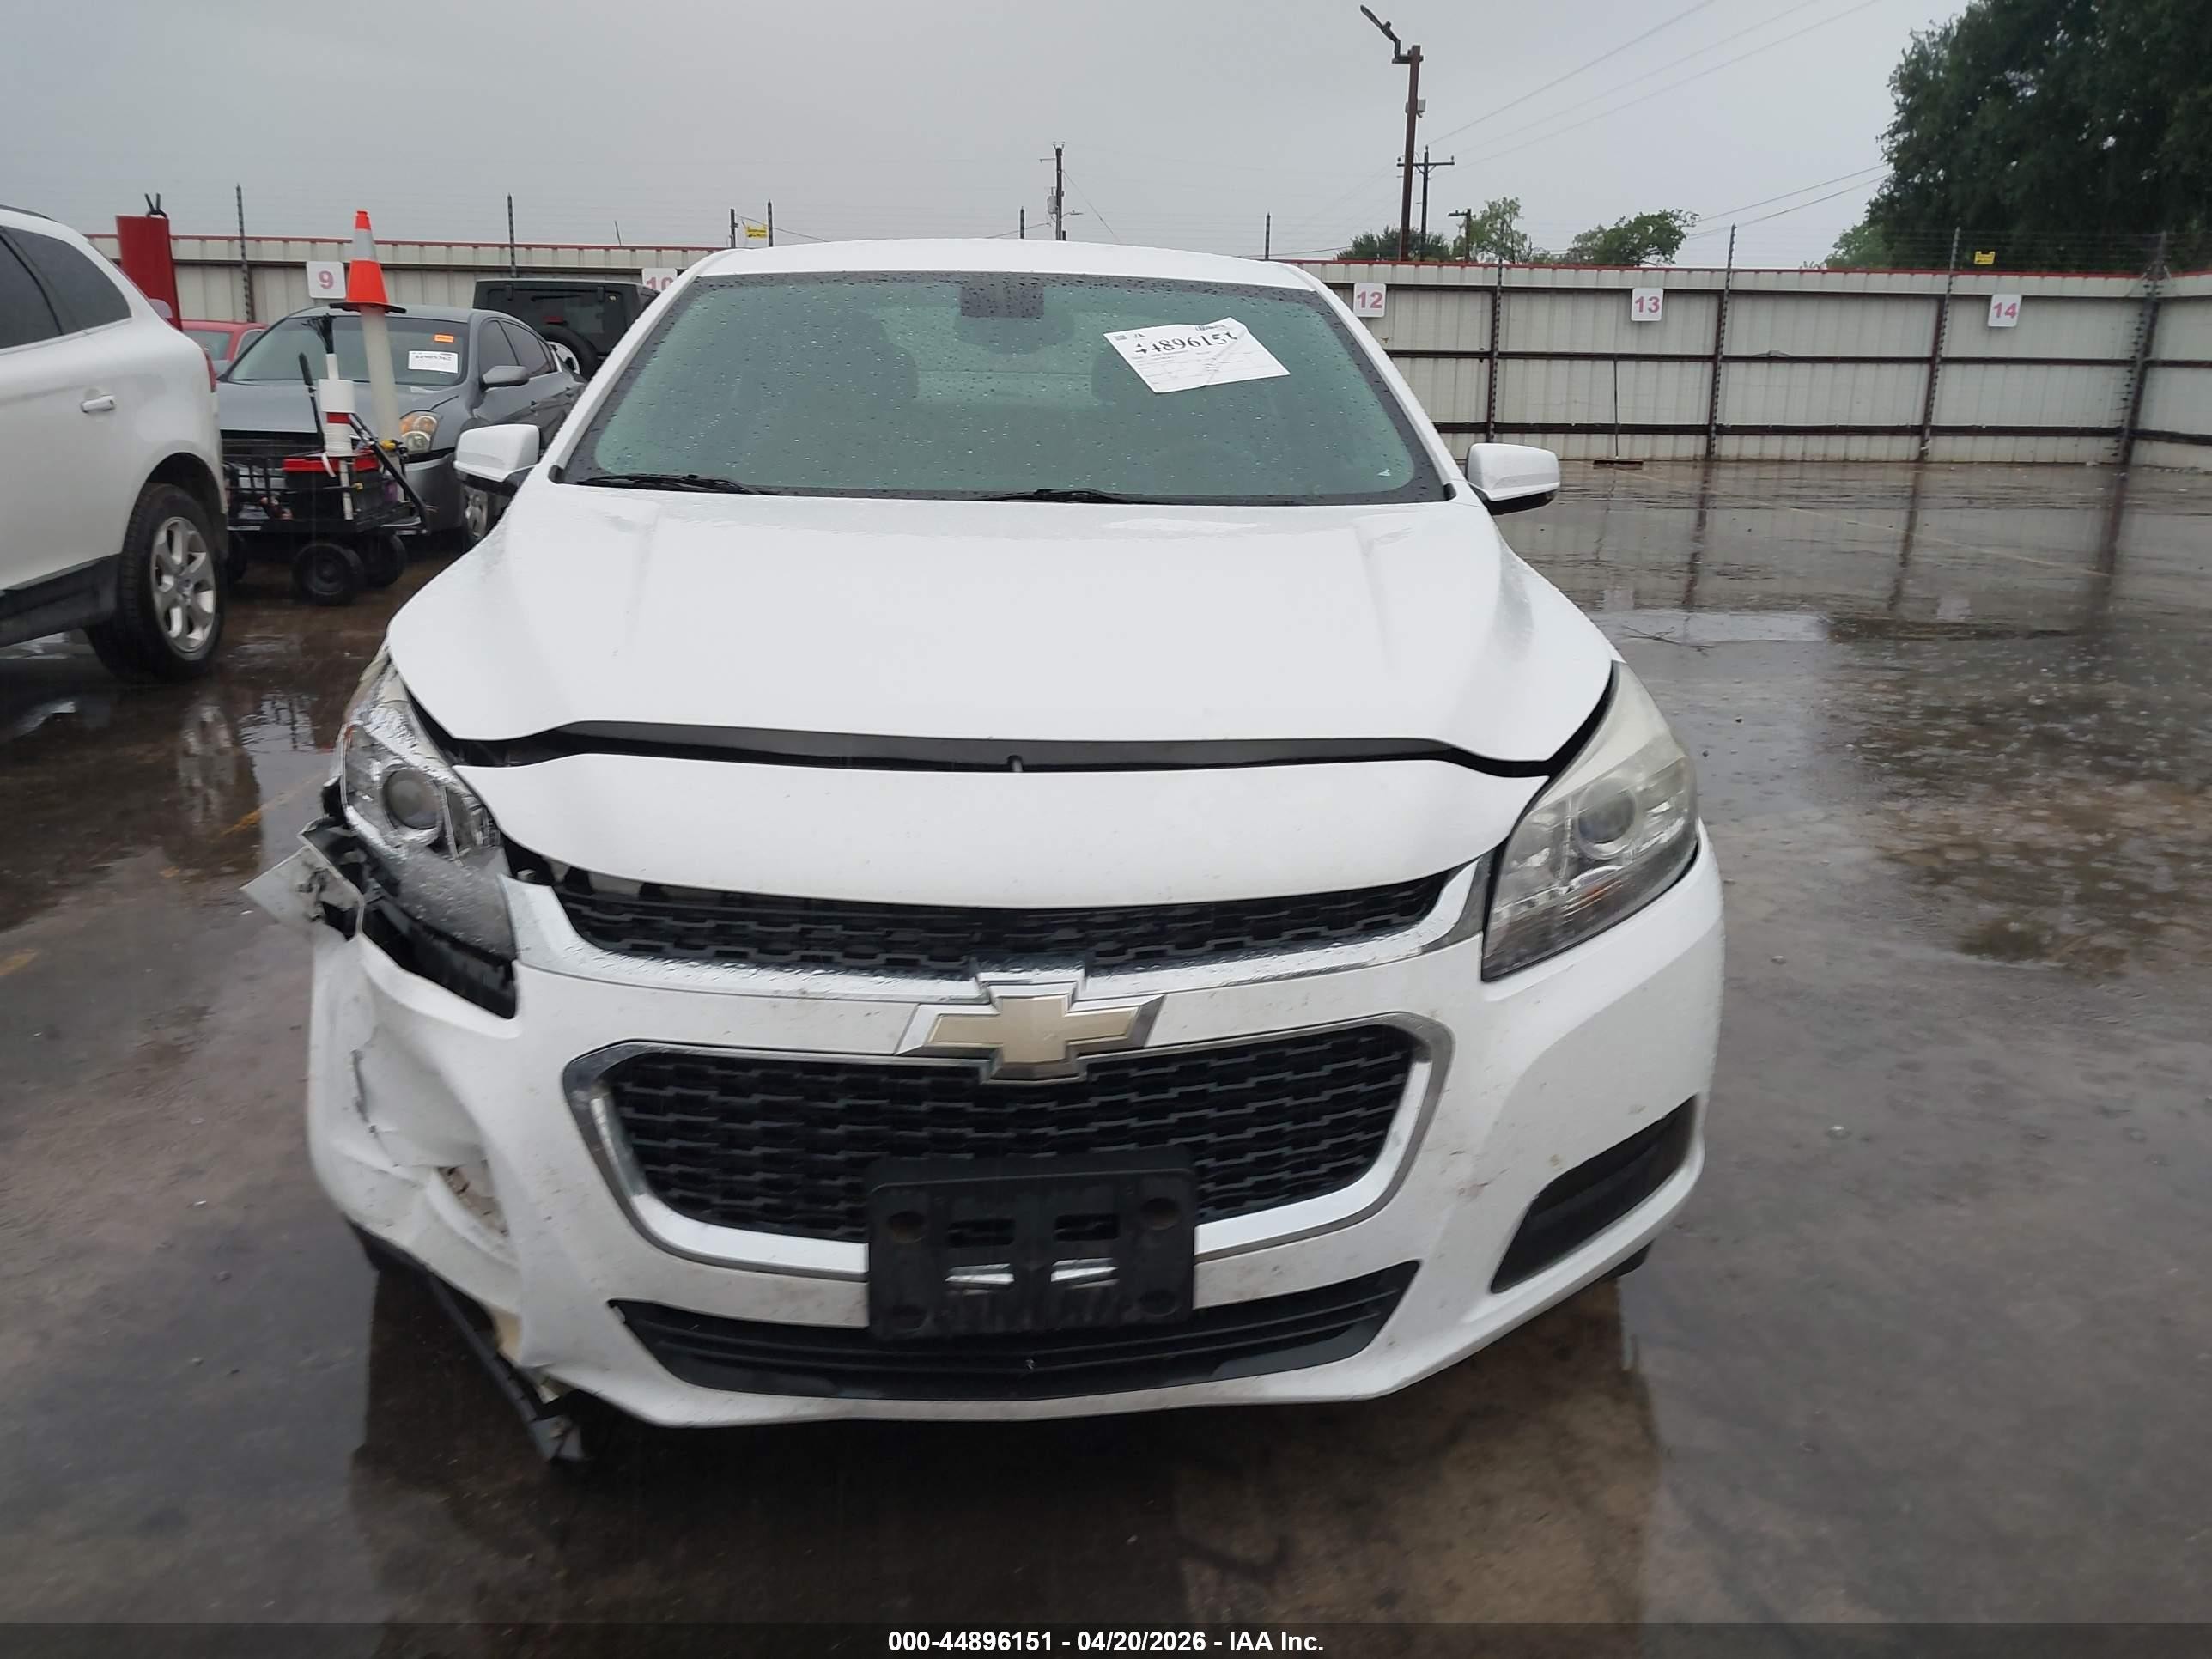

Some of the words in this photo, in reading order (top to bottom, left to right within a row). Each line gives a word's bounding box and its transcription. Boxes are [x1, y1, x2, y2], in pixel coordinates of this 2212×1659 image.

[319, 270, 334, 289] 9
[1357, 291, 1382, 309] 12
[1635, 295, 1660, 313] 13
[1994, 301, 2017, 319] 14
